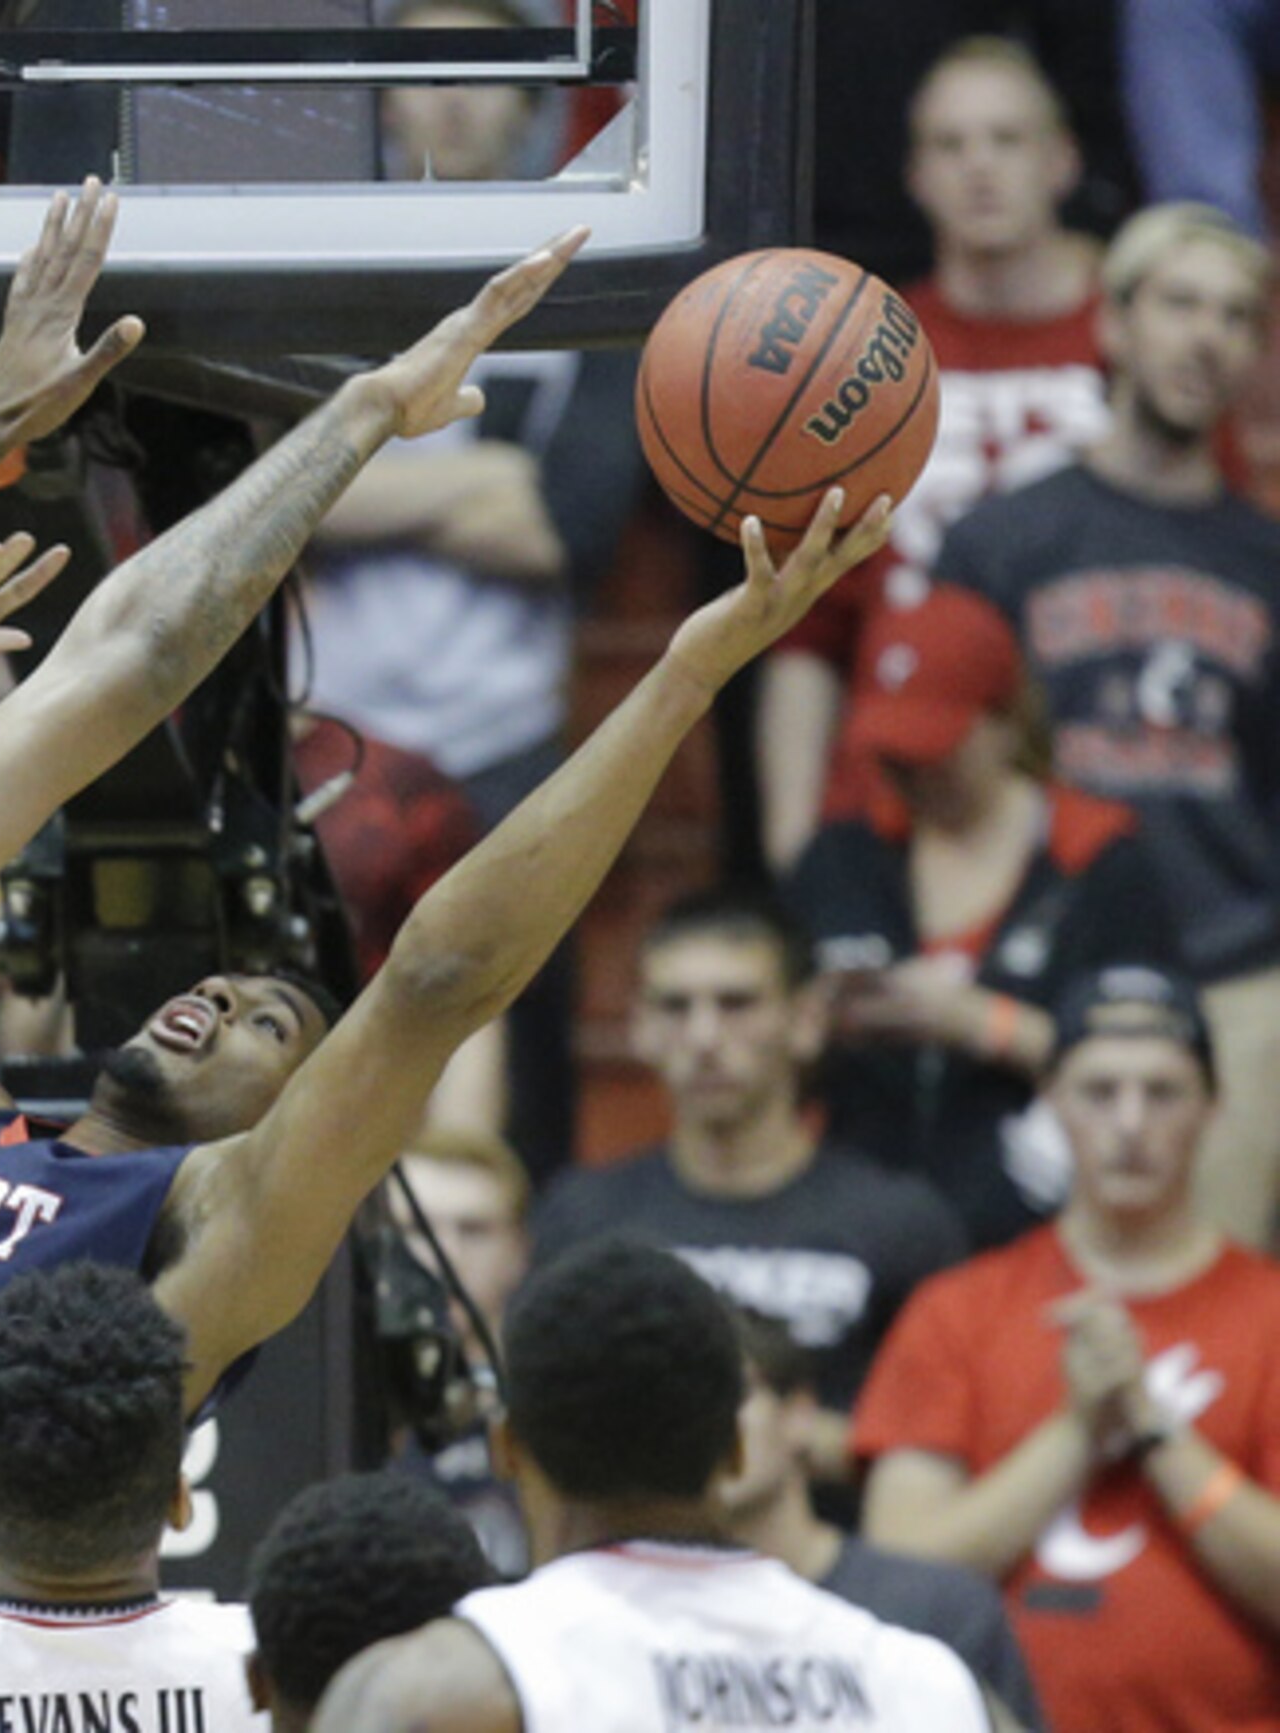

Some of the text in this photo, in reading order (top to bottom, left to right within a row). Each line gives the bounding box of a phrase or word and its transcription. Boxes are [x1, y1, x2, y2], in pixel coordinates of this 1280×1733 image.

[747, 262, 840, 376] NCAA
[803, 291, 919, 444] Wilson
[156, 1687, 205, 1733] III
[651, 1651, 878, 1733] JOHNSON
